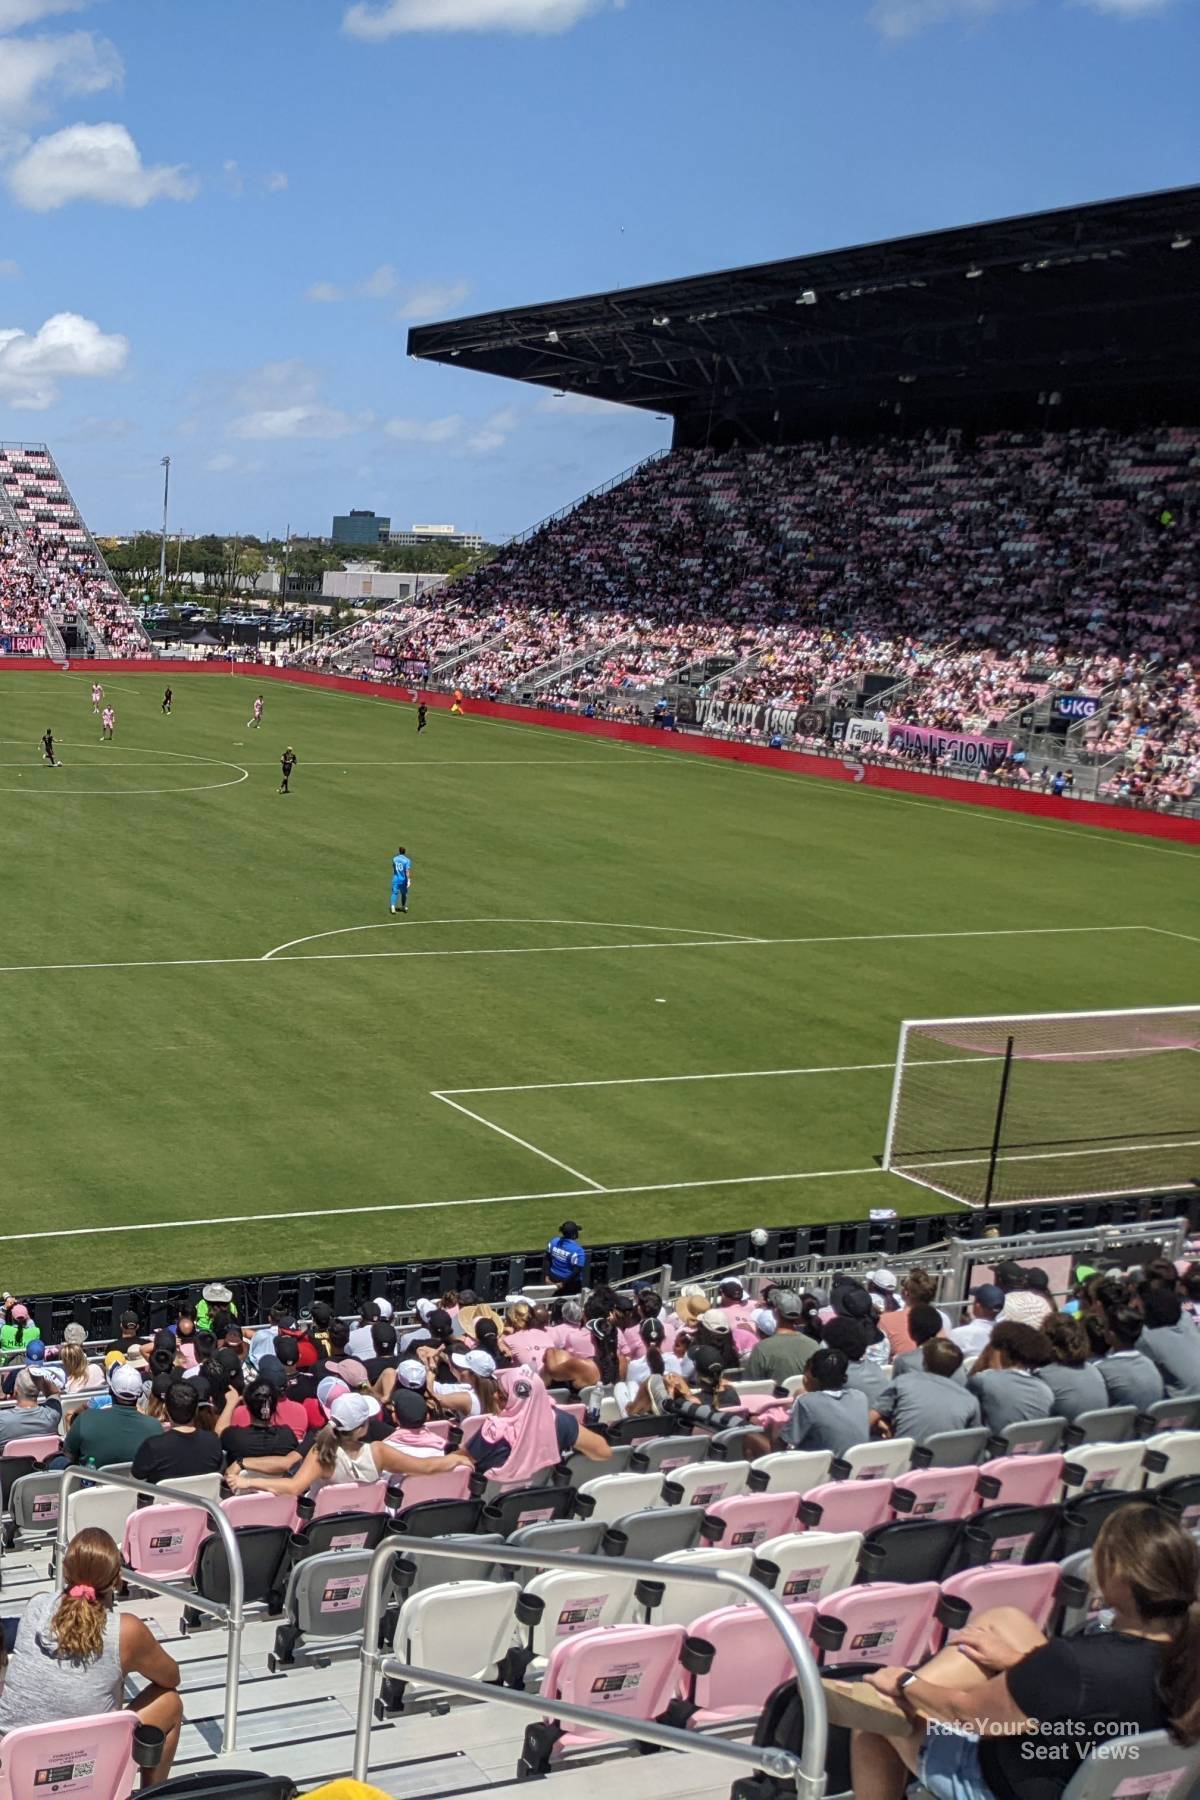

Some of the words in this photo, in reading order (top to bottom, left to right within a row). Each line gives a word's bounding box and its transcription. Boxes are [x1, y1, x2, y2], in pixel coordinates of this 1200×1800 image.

[11, 637, 45, 650] LEGION
[1060, 698, 1096, 716] UKG
[695, 699, 724, 723] VICE
[727, 702, 761, 728] CITY
[763, 707, 798, 736] 1896
[850, 723, 883, 743] Familia
